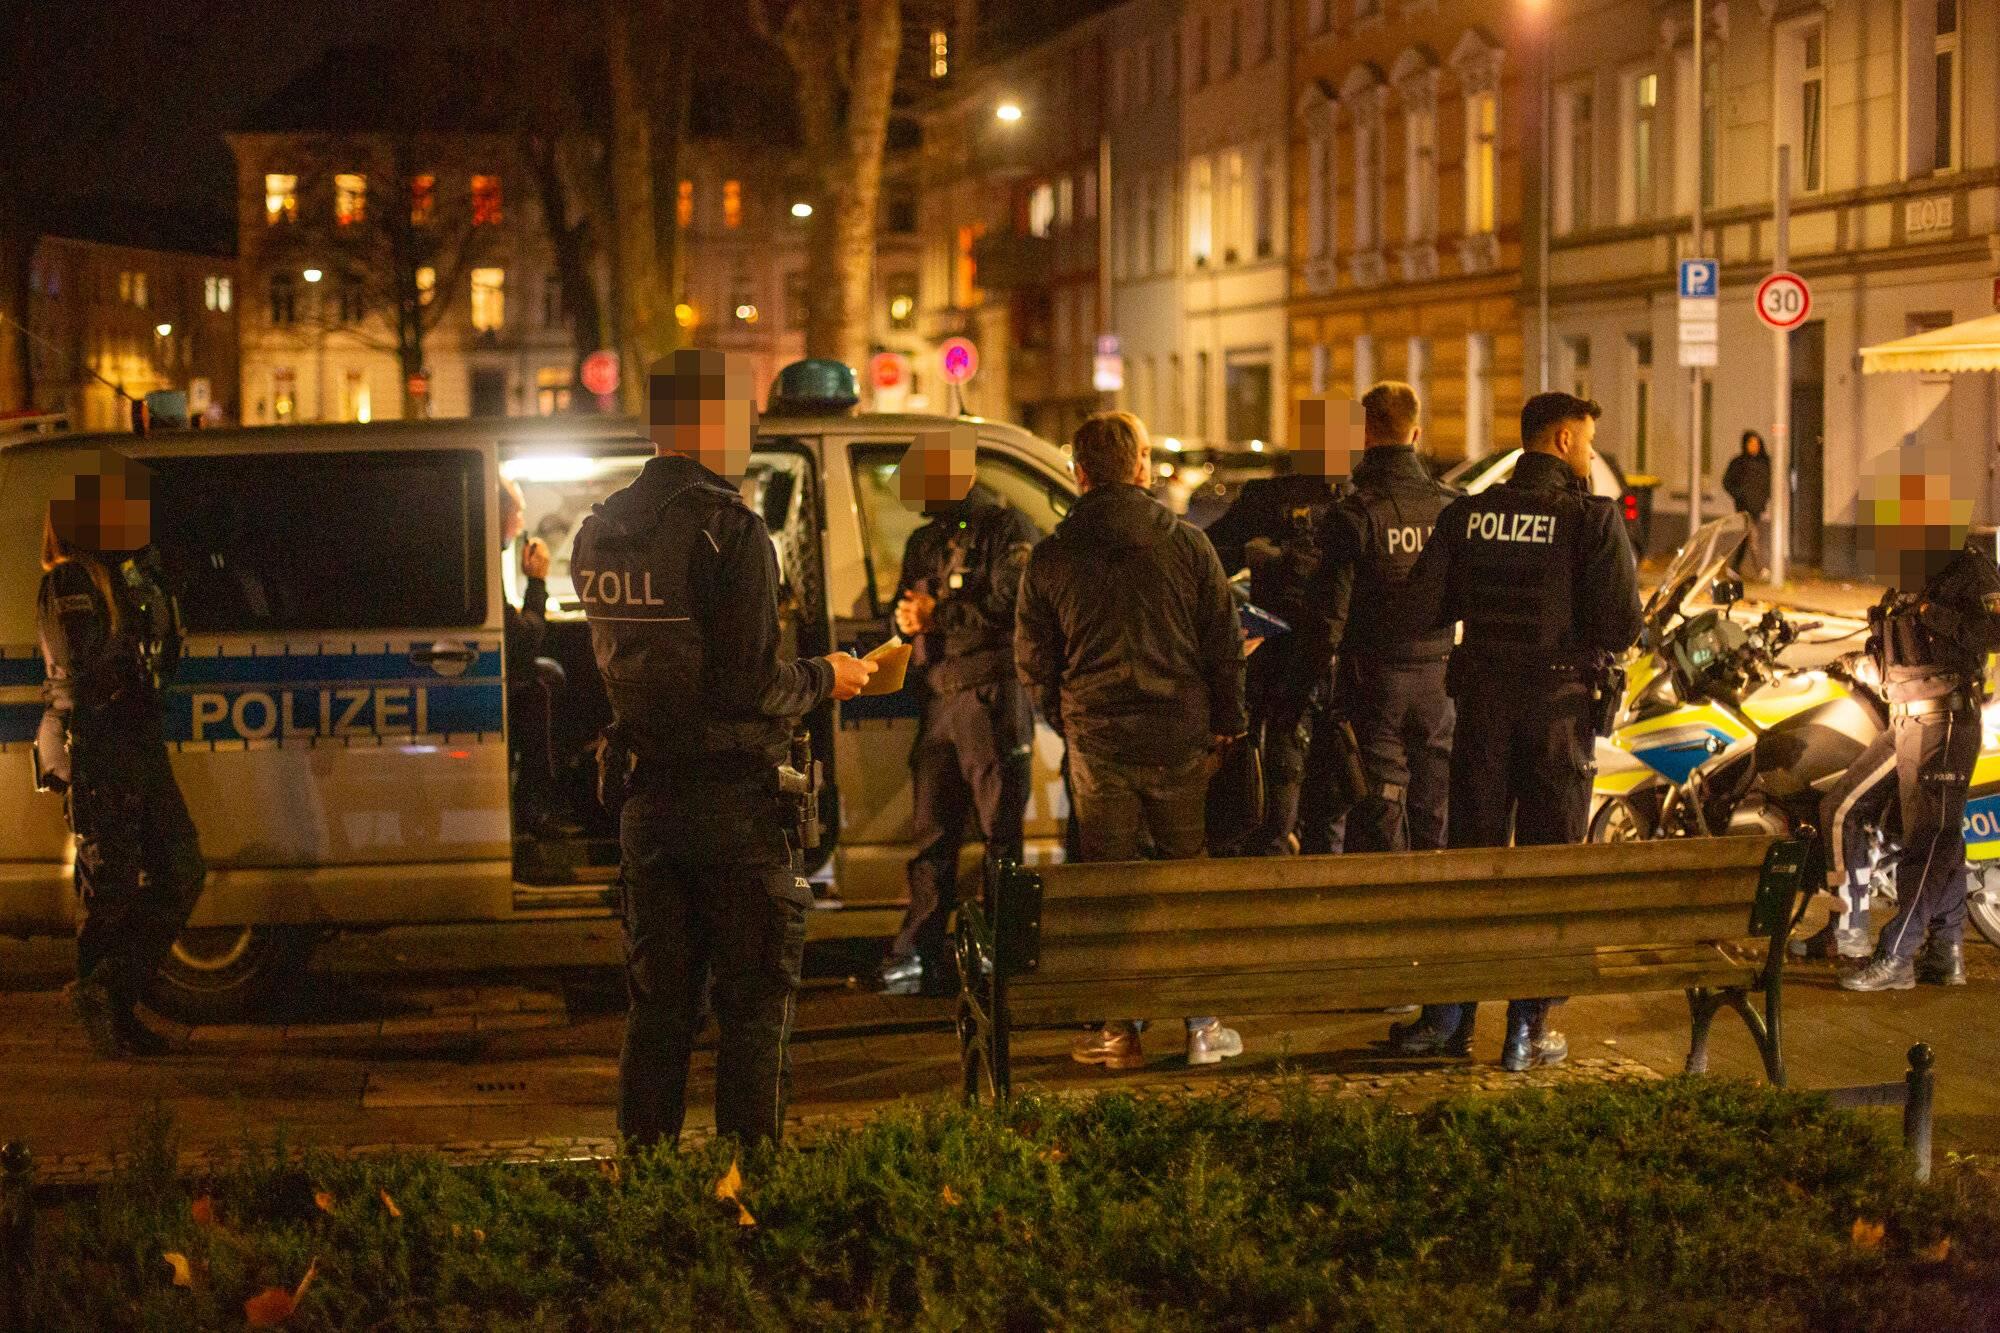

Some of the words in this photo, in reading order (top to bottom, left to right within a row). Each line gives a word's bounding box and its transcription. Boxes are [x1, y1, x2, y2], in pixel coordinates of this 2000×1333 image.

[1686, 263, 1709, 295] P
[1768, 288, 1799, 312] 30
[580, 570, 664, 605] ZOLL
[192, 688, 428, 741] POLIZEI
